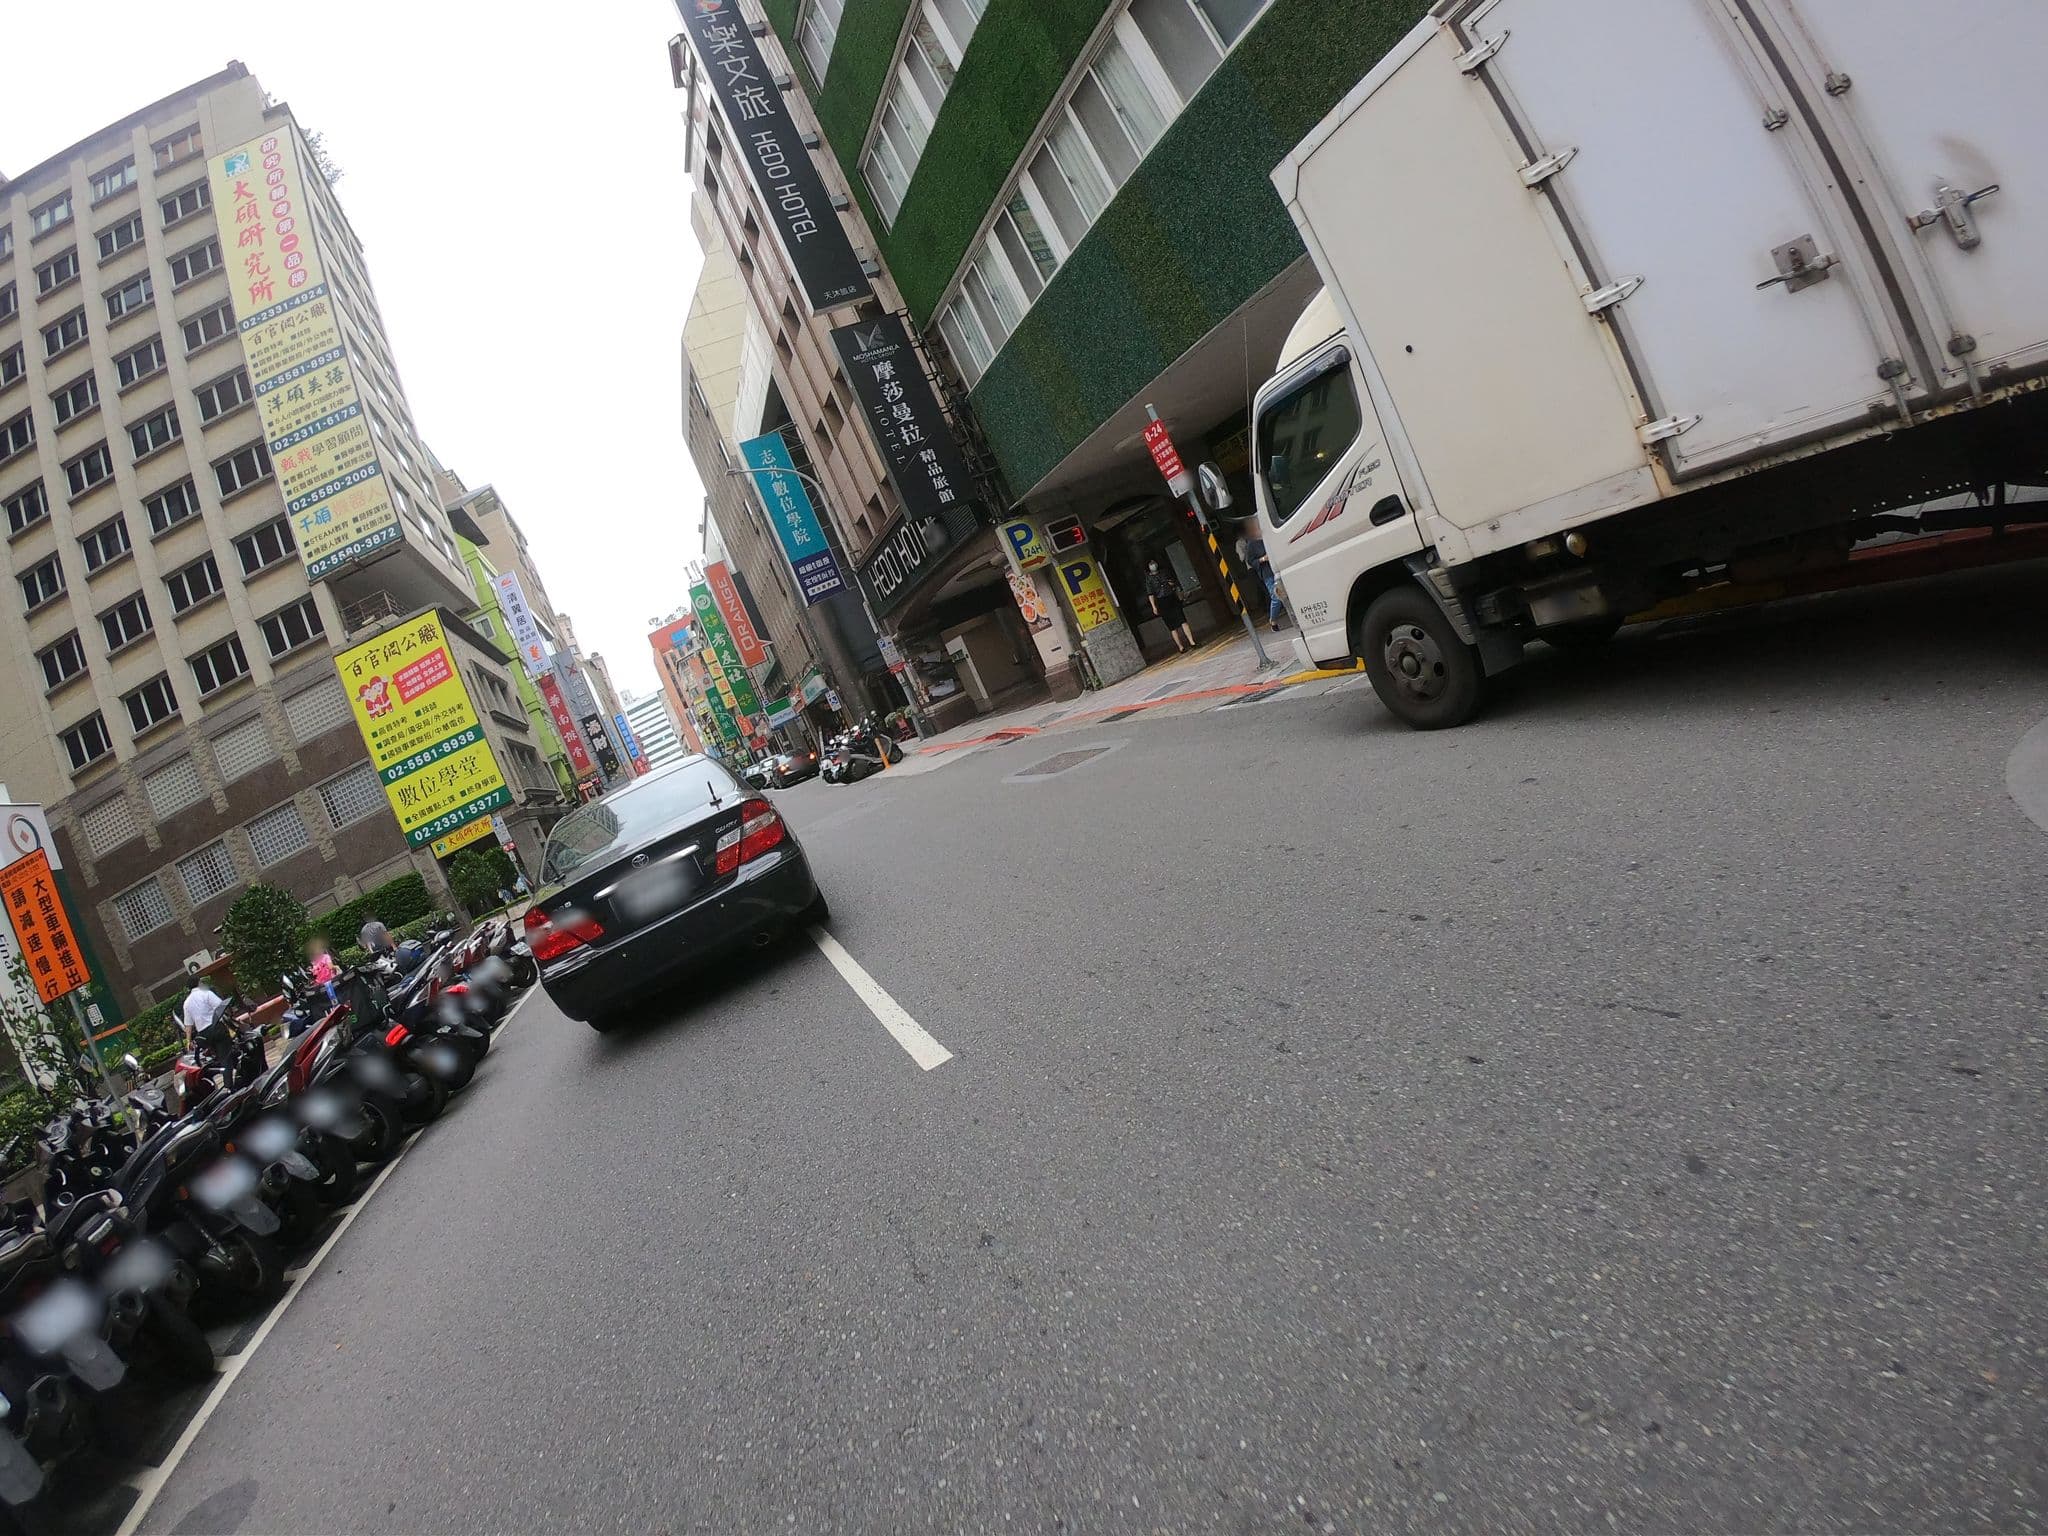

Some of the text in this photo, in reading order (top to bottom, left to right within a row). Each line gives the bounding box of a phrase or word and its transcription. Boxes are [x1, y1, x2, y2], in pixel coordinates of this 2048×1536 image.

[751, 130, 818, 243] HEDO HOTEL
[232, 180, 275, 305] 大碩研究所
[242, 287, 323, 329] 02-2331-4924
[259, 350, 340, 393] 02-5581-8938
[853, 343, 900, 361] MOSHAMANLA
[267, 366, 344, 414] 洋碩美語
[871, 360, 925, 446] 摩莎曼拉
[275, 406, 357, 450] 02-2311-6178
[874, 404, 906, 464] HOTEL
[1145, 424, 1162, 441] 0-24
[292, 465, 376, 511] 02-5580-2006
[759, 449, 811, 546] 志光數位學院
[919, 448, 956, 504] 精品旅館
[312, 527, 396, 574] 02-5580-3872
[1005, 523, 1042, 560] P 24H
[867, 546, 903, 602] HEDO
[1062, 562, 1091, 595] P
[716, 577, 755, 651] ORANGE
[1092, 607, 1109, 625] 25
[712, 631, 745, 684] 考友社
[387, 731, 475, 780] 02-5581-8938
[398, 756, 482, 809] 數位學堂
[414, 792, 501, 841] 02-2331-5377
[10, 887, 59, 998] 請減速慢行
[33, 877, 83, 989] 大型車輛進出
[0, 934, 35, 1013] Finaial
